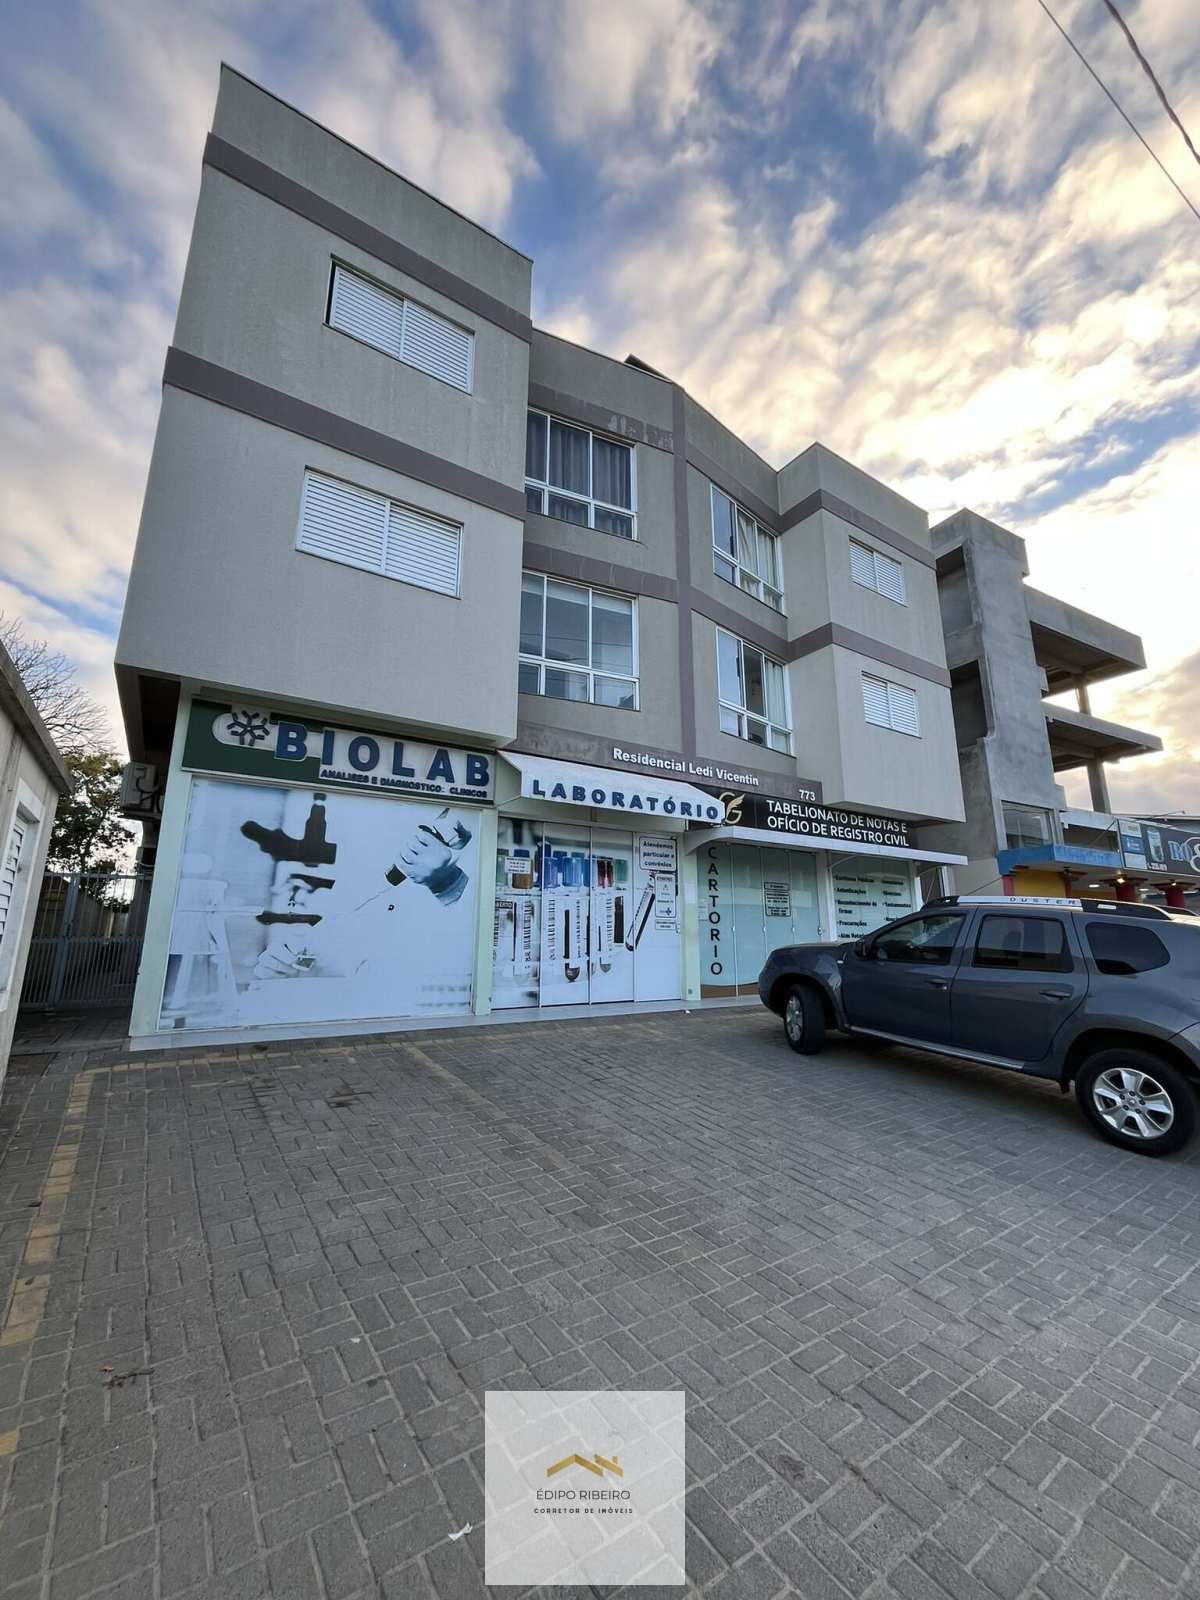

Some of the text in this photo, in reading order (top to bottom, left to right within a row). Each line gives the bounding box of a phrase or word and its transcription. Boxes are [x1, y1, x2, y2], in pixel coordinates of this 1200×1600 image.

[275, 721, 490, 787] BIOLAB
[613, 747, 759, 786] Residencial Ledi Vicentin
[532, 778, 719, 820] LABORATÓRIO
[799, 789, 816, 801] 773
[766, 799, 908, 833] TABELIONATO DE NOTAS E
[767, 814, 909, 847] OFÍCIO DE REGISTRO CIVIL
[1009, 896, 1076, 905] DUSTER
